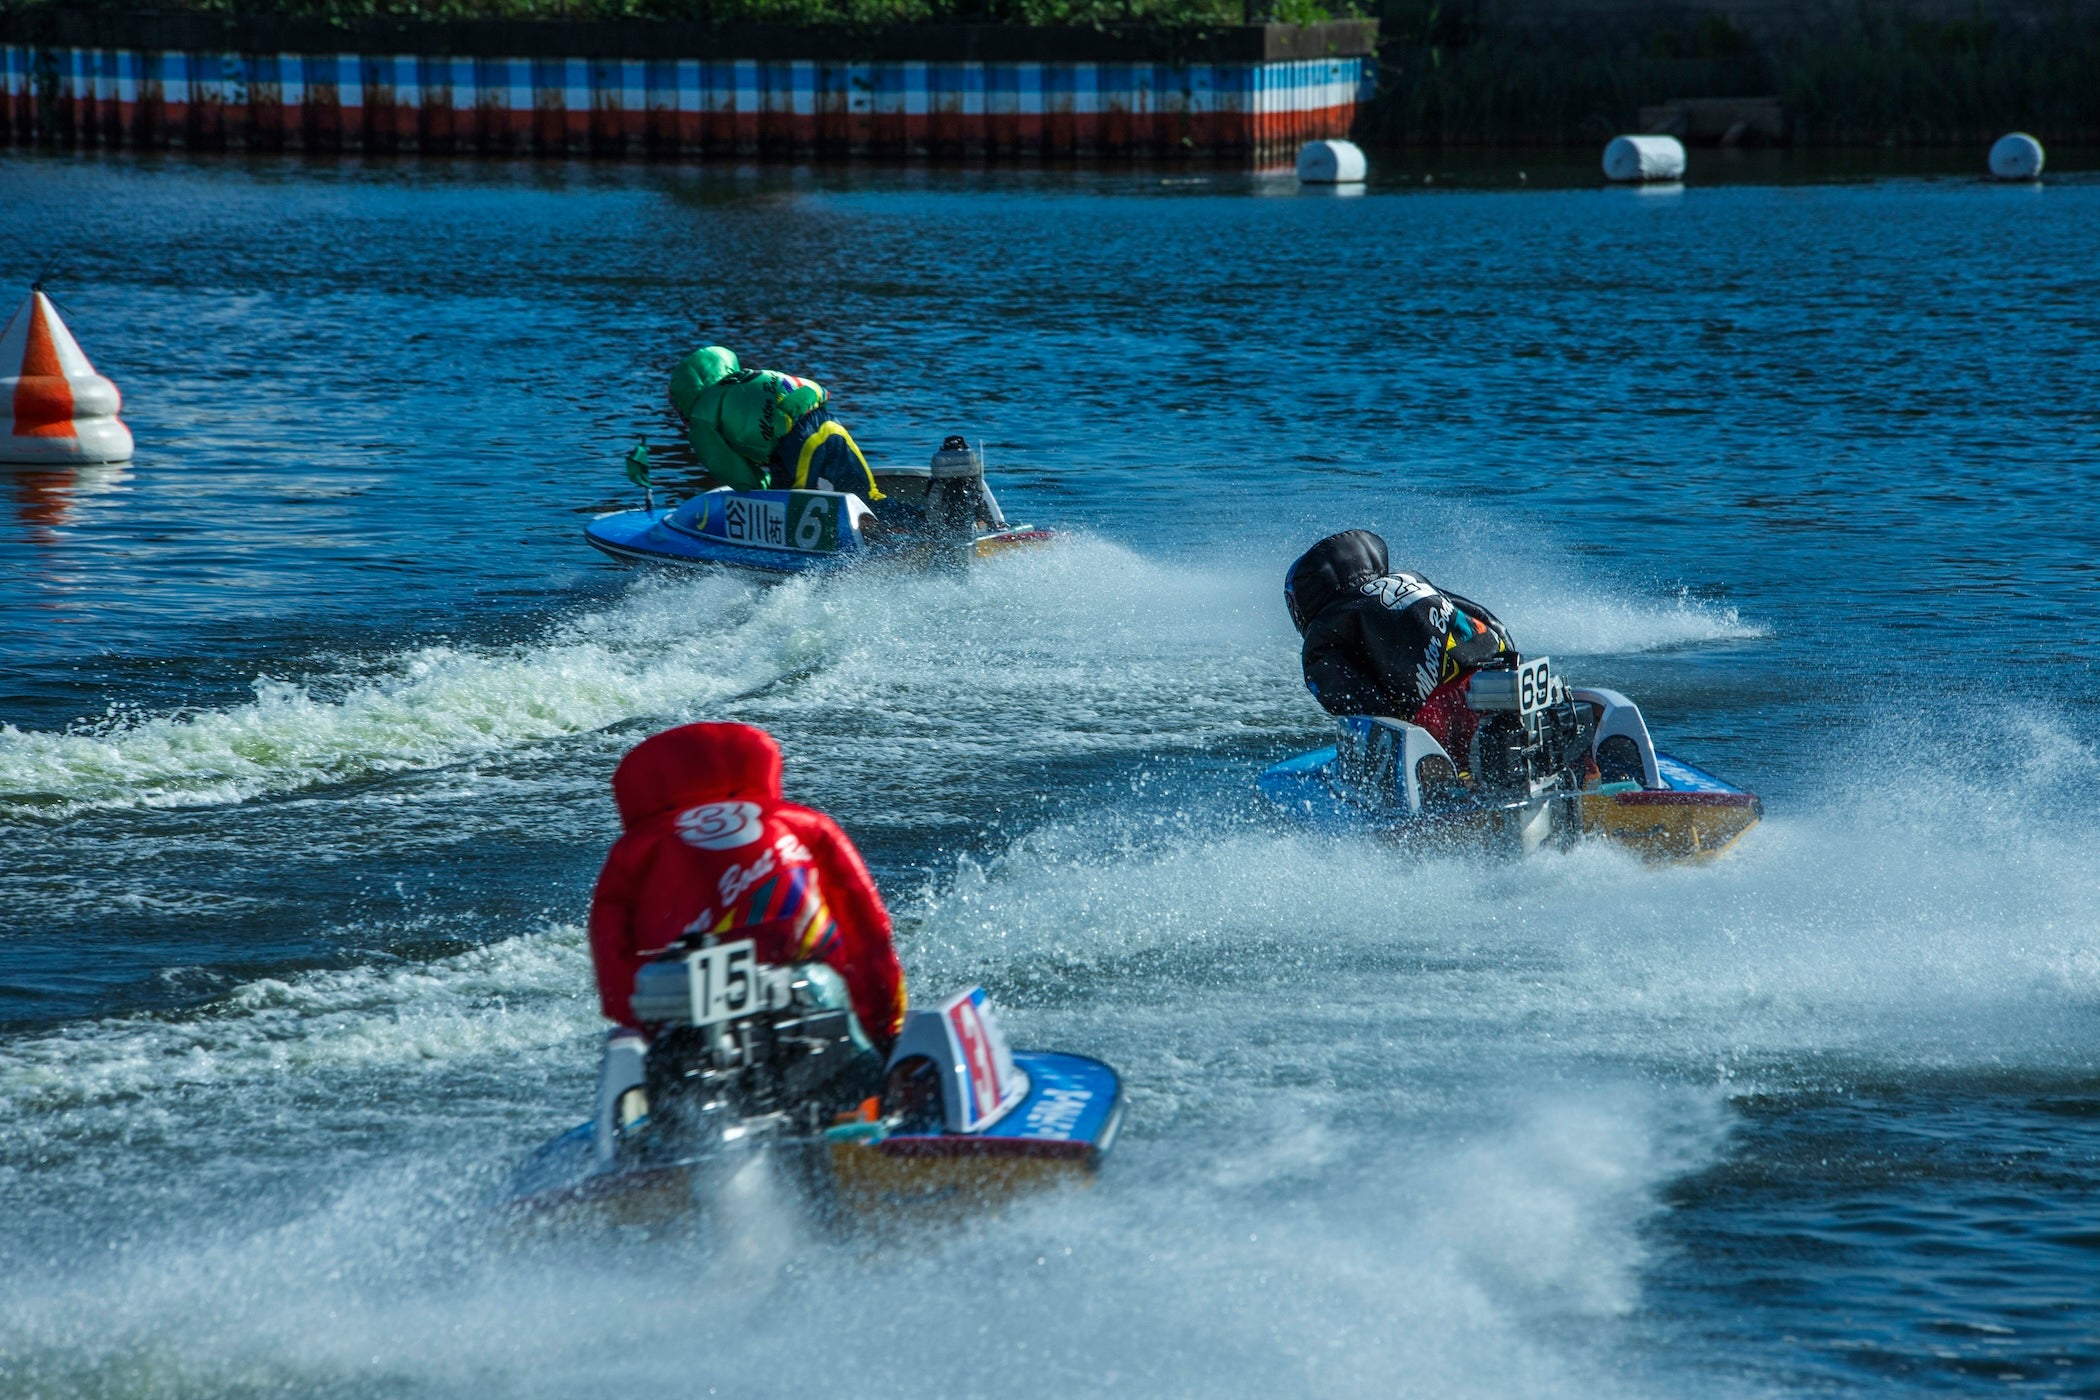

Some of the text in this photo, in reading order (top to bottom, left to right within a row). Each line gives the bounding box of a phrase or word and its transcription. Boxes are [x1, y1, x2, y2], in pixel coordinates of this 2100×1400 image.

[795, 497, 829, 549] 6
[1361, 574, 1422, 609] 2
[1416, 635, 1442, 700] Motor
[1522, 662, 1549, 710] 69
[676, 803, 750, 846] 3
[718, 847, 776, 908] Boat
[698, 948, 750, 1018] 15
